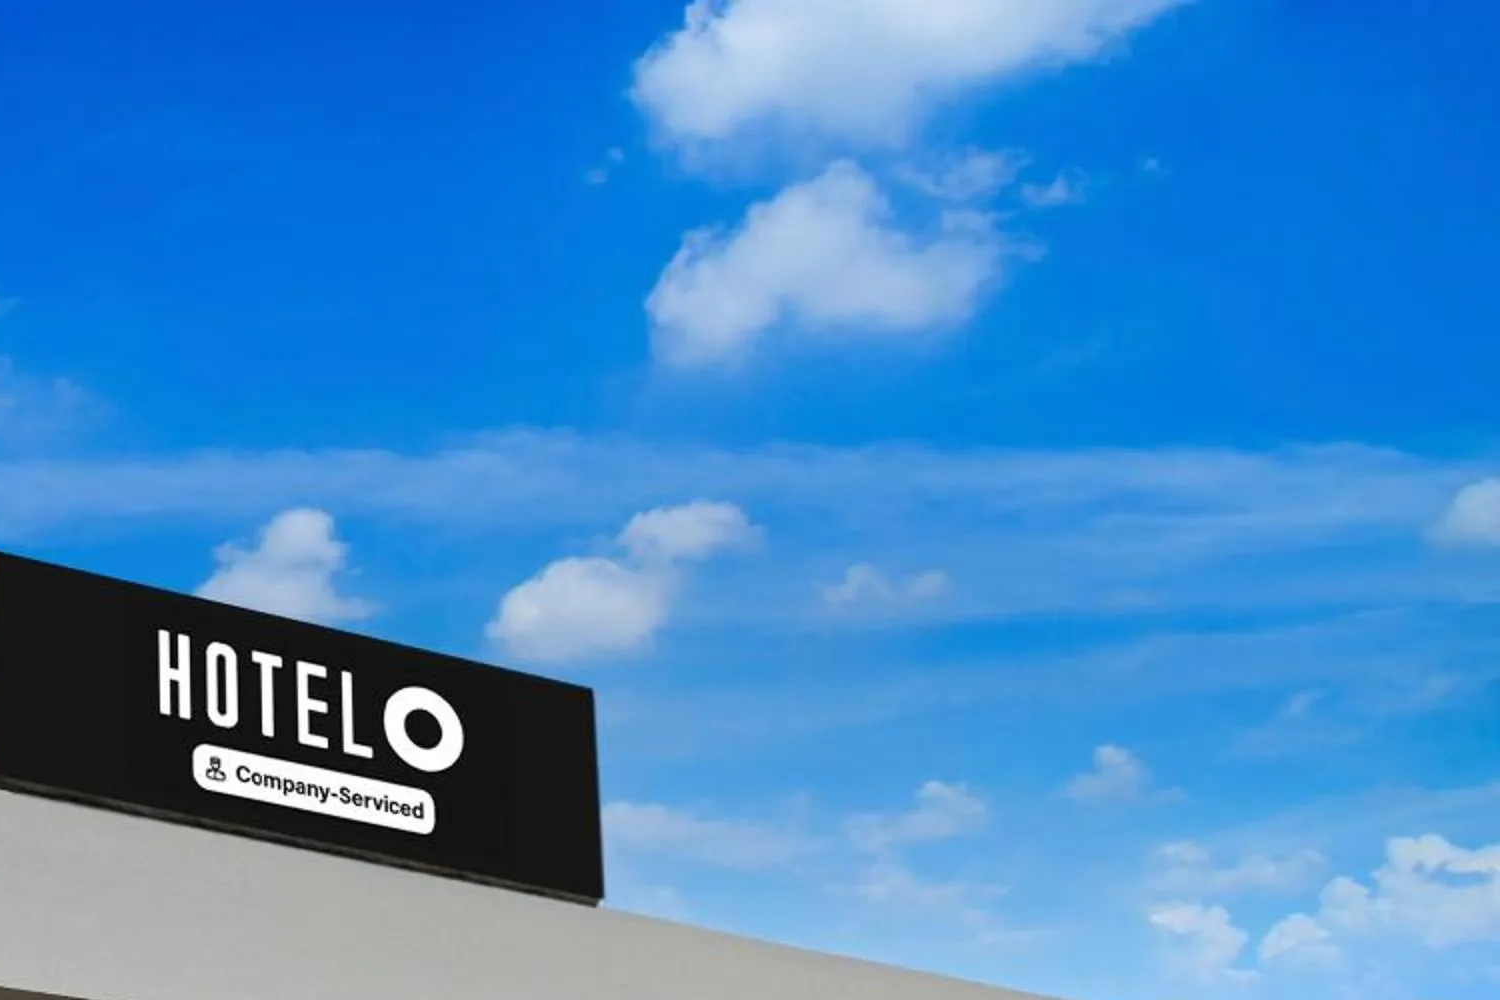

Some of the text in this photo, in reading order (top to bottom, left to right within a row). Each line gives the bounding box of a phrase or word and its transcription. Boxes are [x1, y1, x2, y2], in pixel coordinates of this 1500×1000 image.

[158, 629, 464, 772] HOTEL O
[235, 765, 425, 820] Company-Serviced
